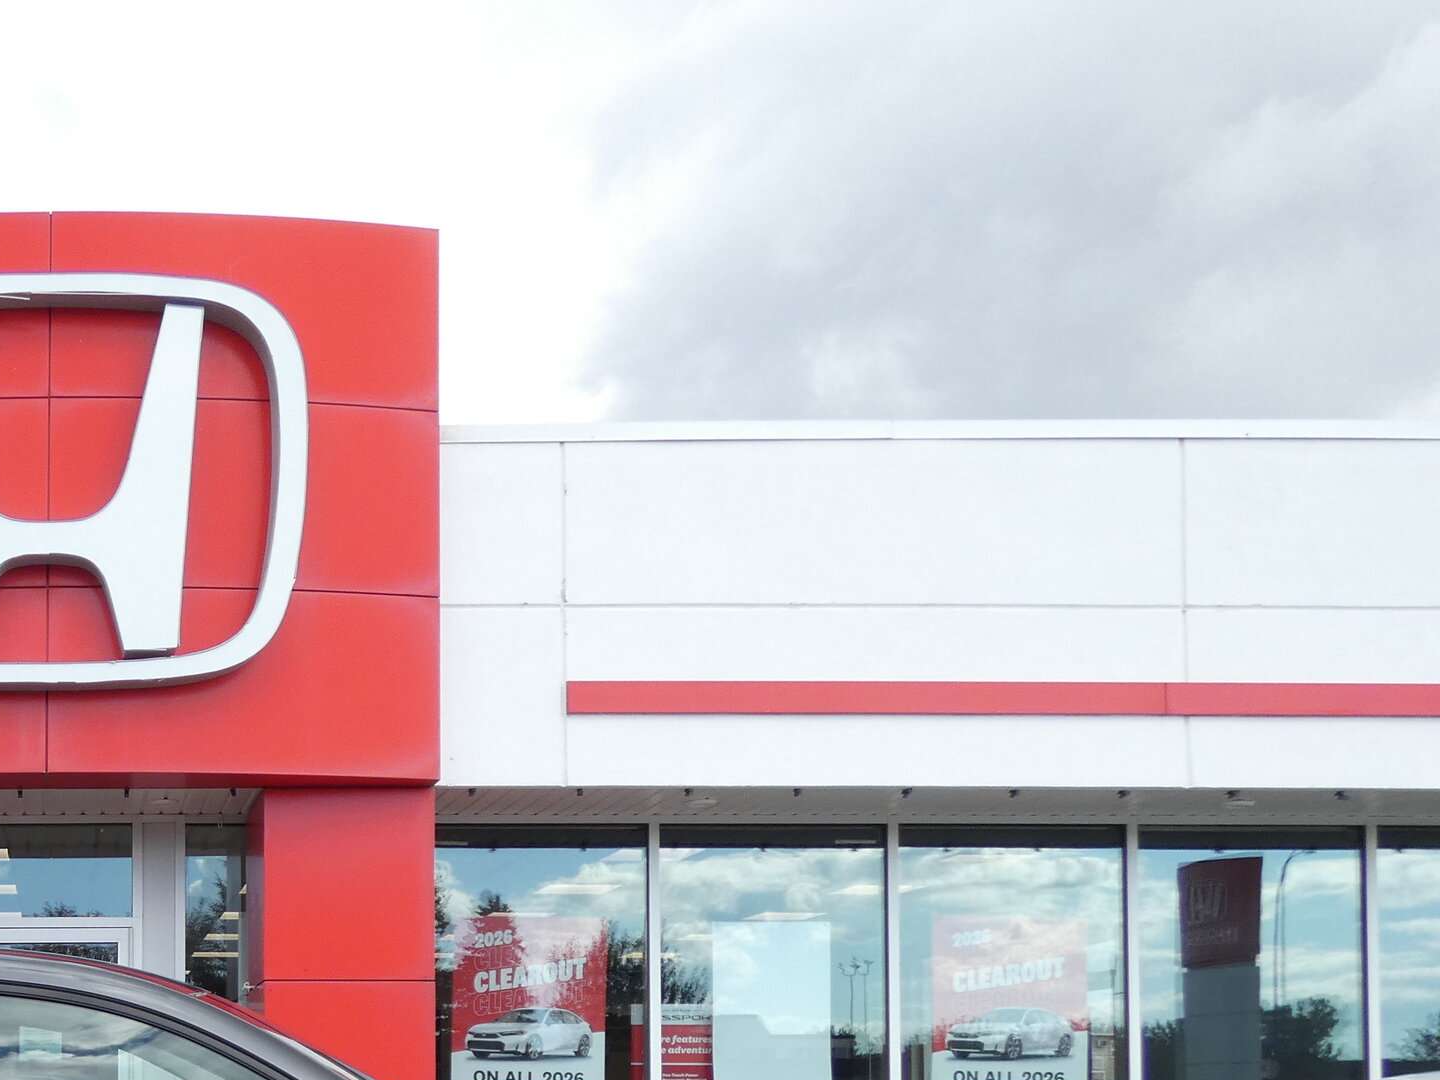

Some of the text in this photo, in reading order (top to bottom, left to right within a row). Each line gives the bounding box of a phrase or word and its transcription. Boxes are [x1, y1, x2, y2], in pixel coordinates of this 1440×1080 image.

[474, 929, 513, 949] 2026
[474, 956, 587, 994] CLEAROUT
[953, 956, 1065, 992] CLEAROUT
